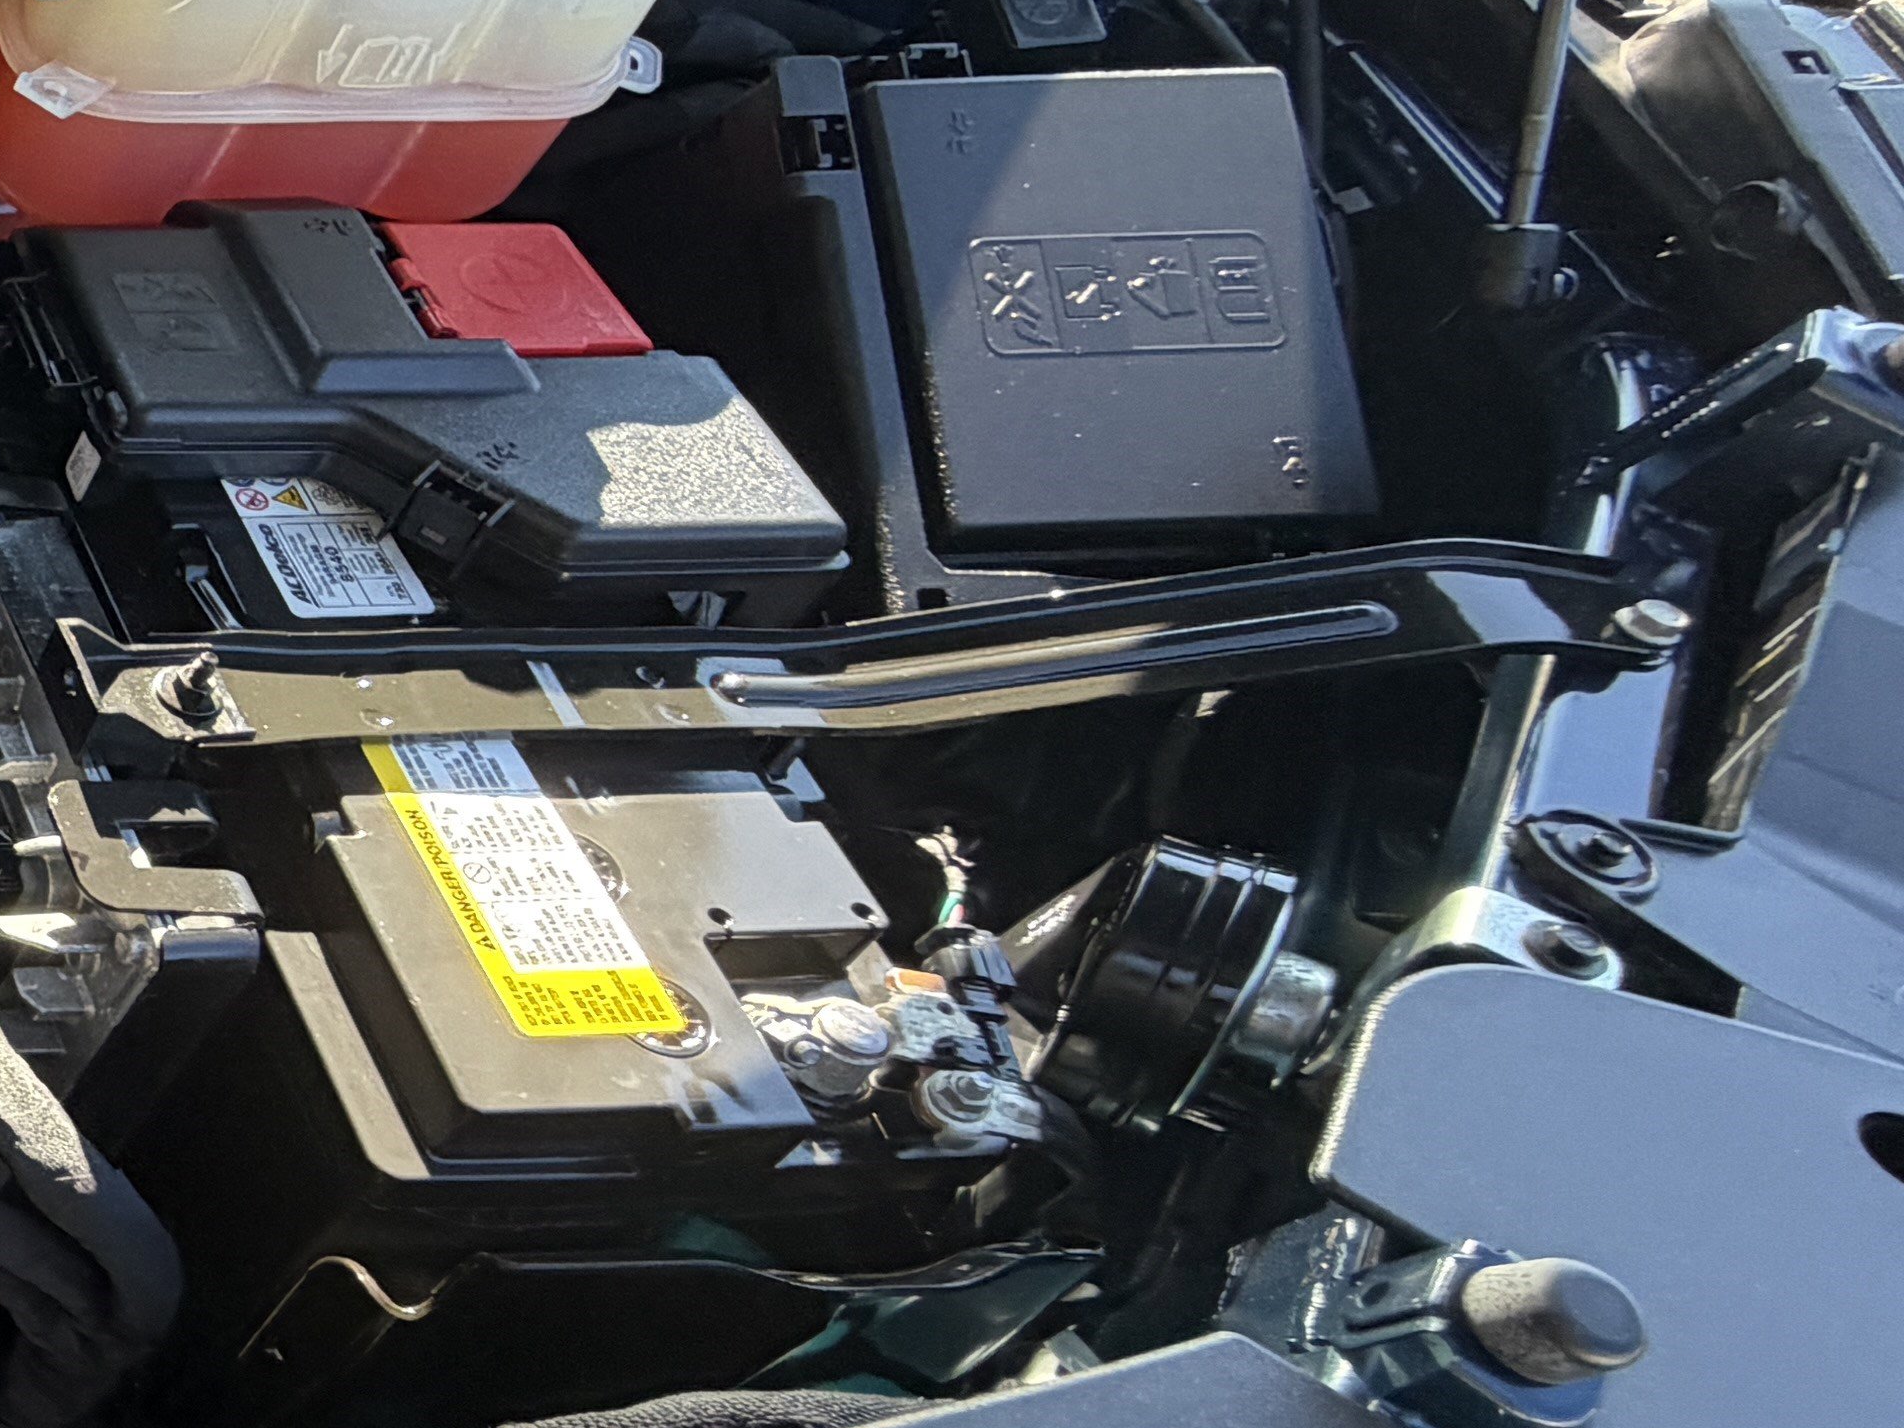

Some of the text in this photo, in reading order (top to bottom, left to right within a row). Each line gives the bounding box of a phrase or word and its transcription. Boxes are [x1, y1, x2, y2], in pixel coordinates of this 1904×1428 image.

[258, 523, 312, 605] ACDelco
[323, 546, 355, 583] 8540
[405, 808, 487, 934] DANGER/POISON
